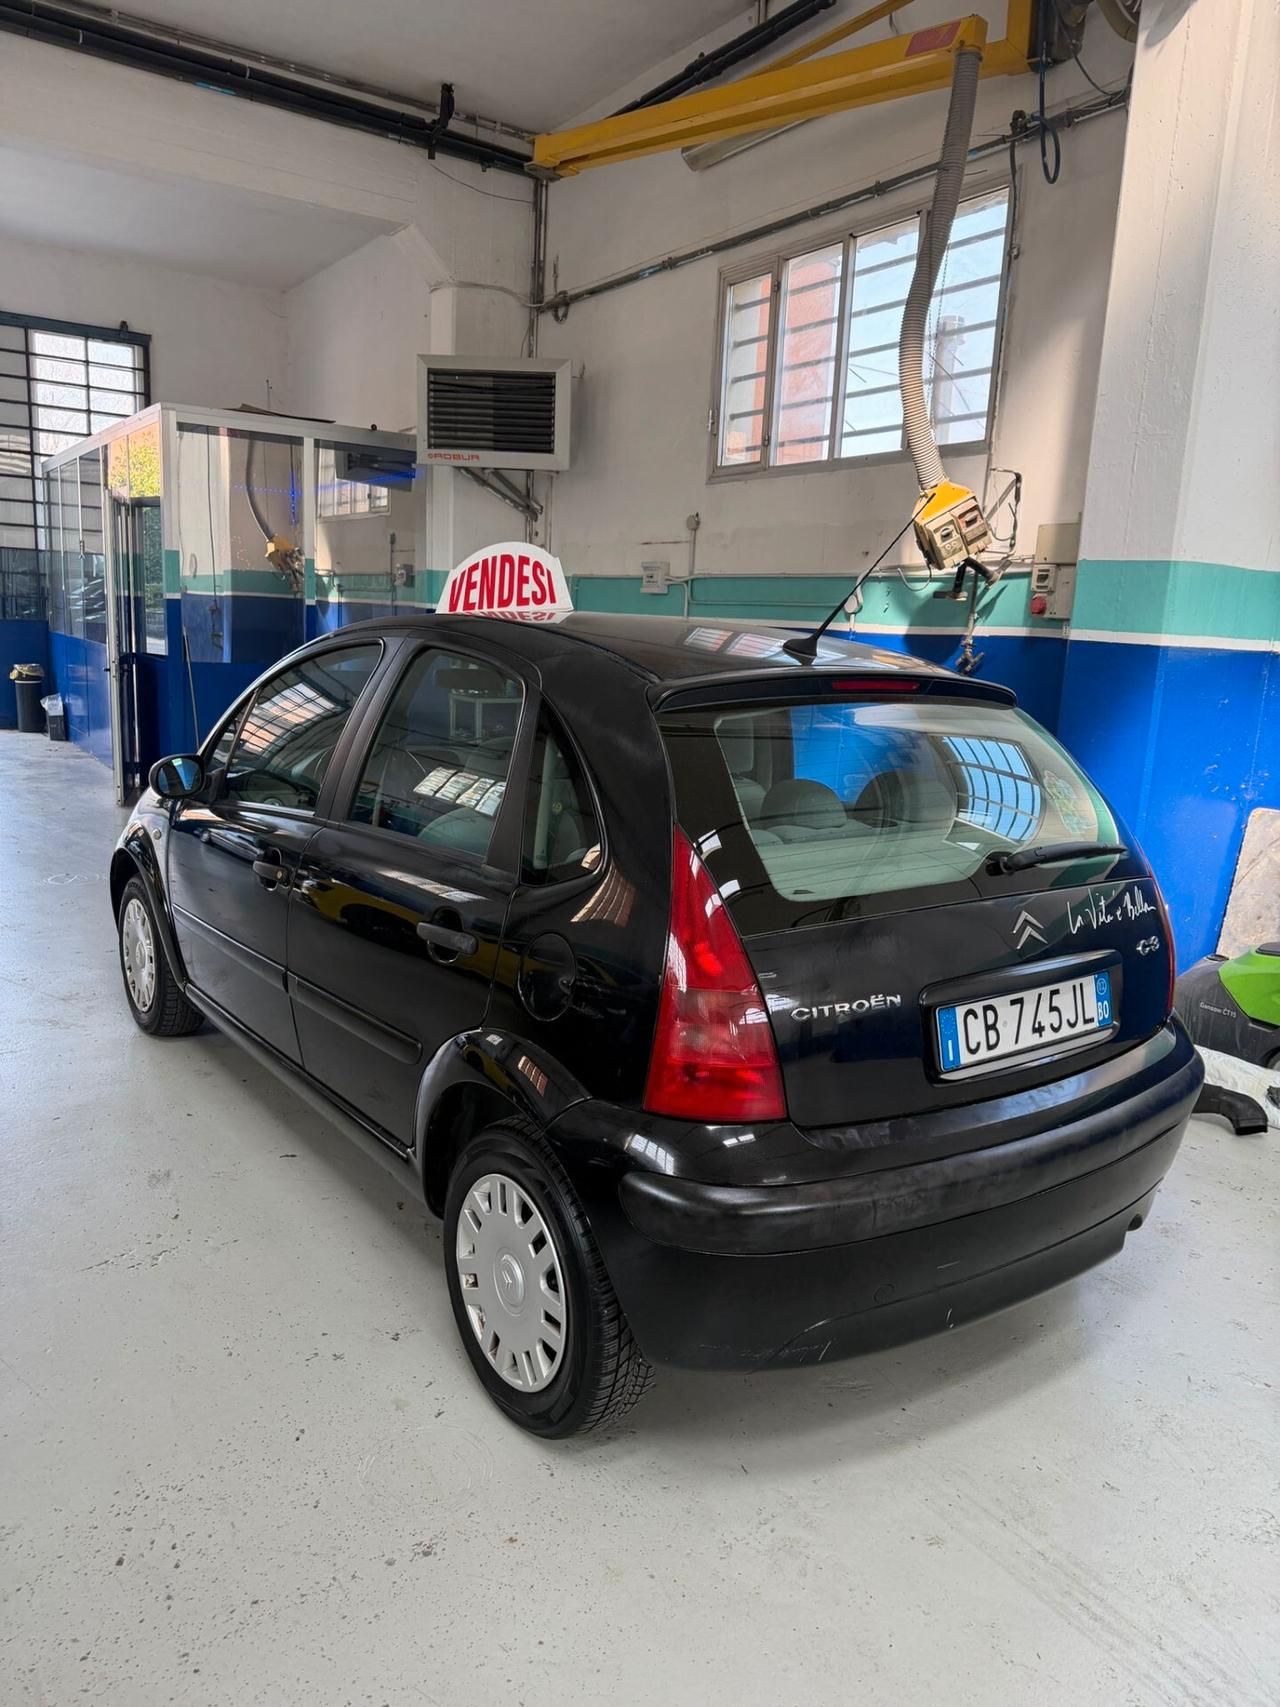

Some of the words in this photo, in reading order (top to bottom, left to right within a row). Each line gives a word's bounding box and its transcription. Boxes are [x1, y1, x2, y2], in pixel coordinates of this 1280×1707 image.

[448, 553, 557, 613] VENDESI
[1136, 935, 1160, 956] C3
[790, 993, 902, 1021] CITROËN
[947, 1039, 955, 1062] I
[962, 1003, 1001, 1056] CB
[1009, 982, 1095, 1046] 745JL
[1097, 1000, 1110, 1021] BO
